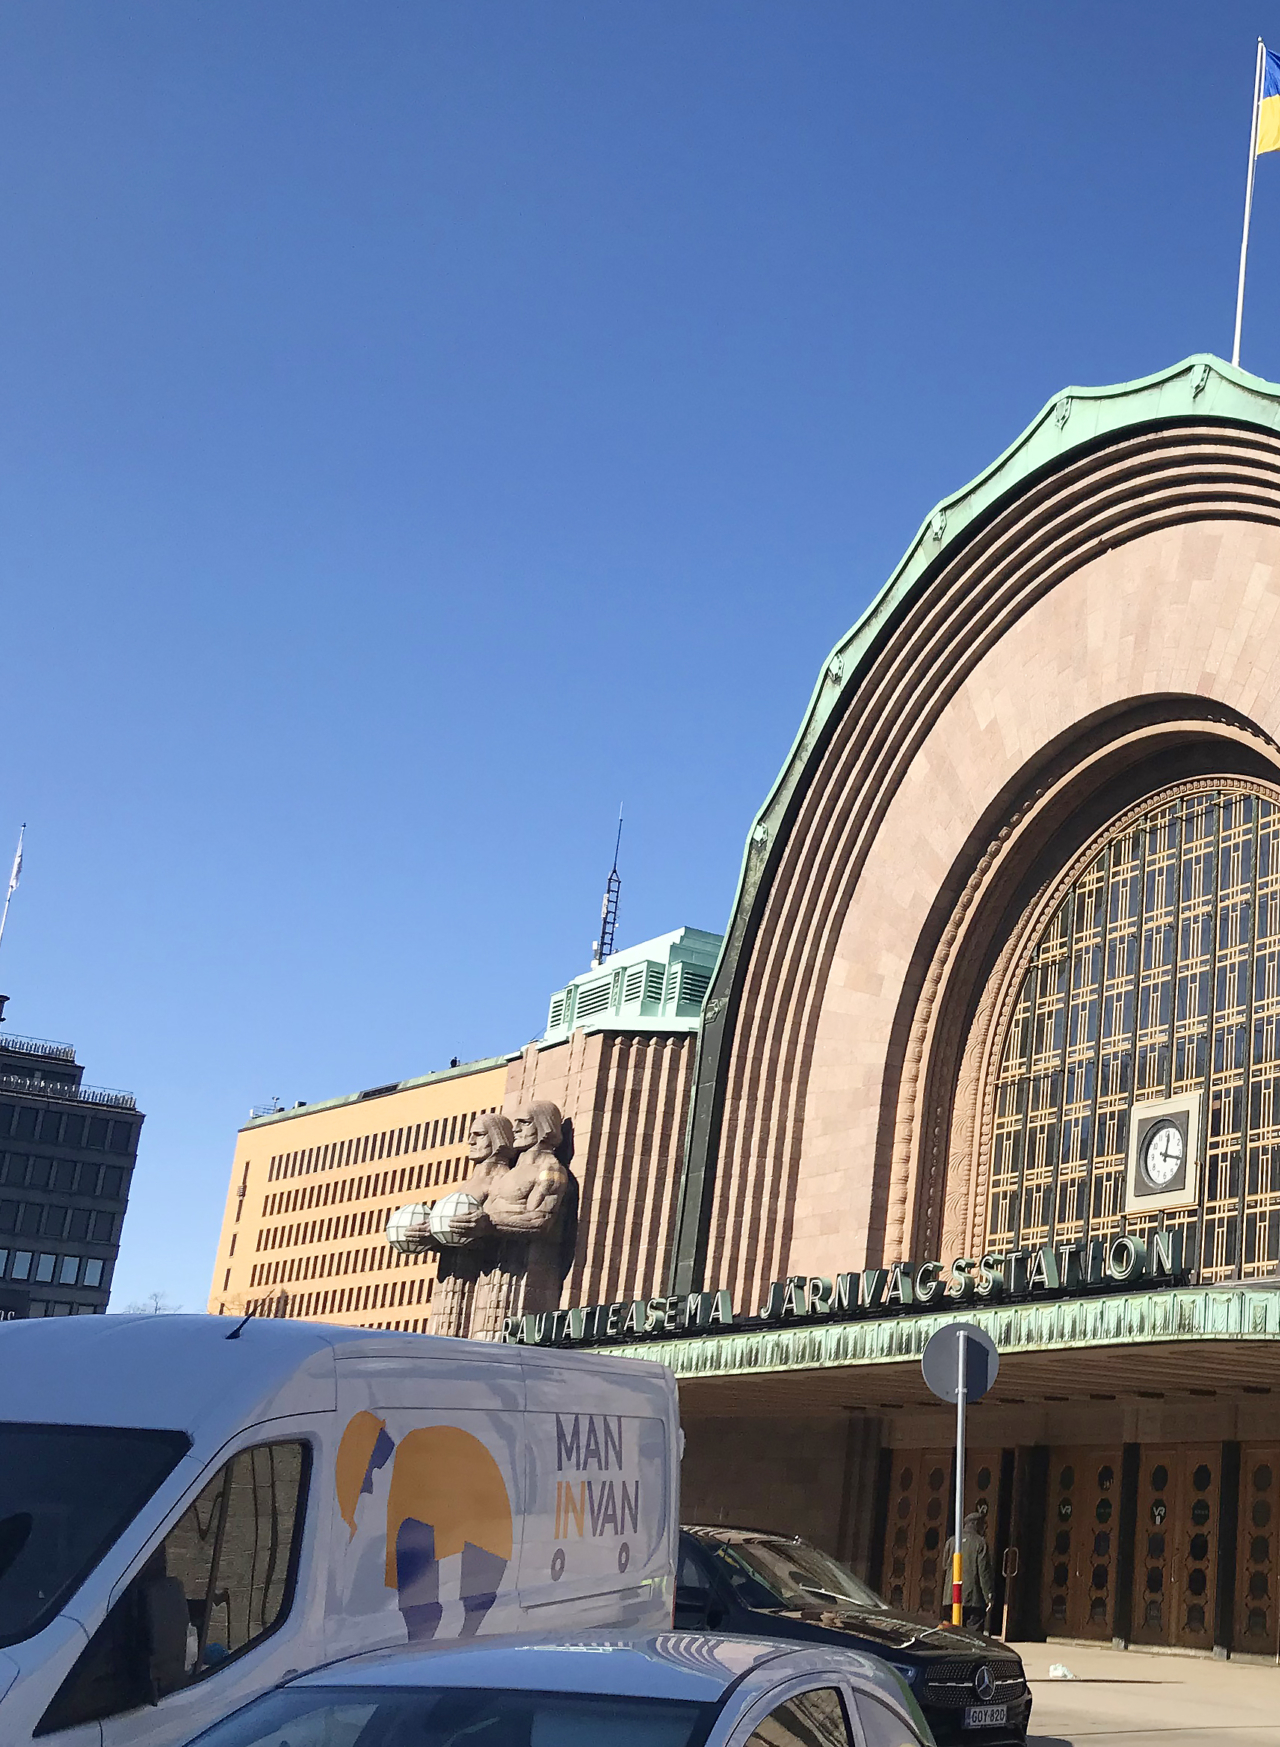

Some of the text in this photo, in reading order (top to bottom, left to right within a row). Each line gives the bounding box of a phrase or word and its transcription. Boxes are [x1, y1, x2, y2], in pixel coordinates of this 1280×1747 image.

[501, 1229, 1182, 1345] RAUTATIEASEMA JÄRNVÄGSSTATION
[555, 1413, 623, 1471] MAN
[1060, 1505, 1072, 1515] VR
[1152, 1506, 1166, 1516] VR
[971, 1709, 1005, 1723] GOY-820
